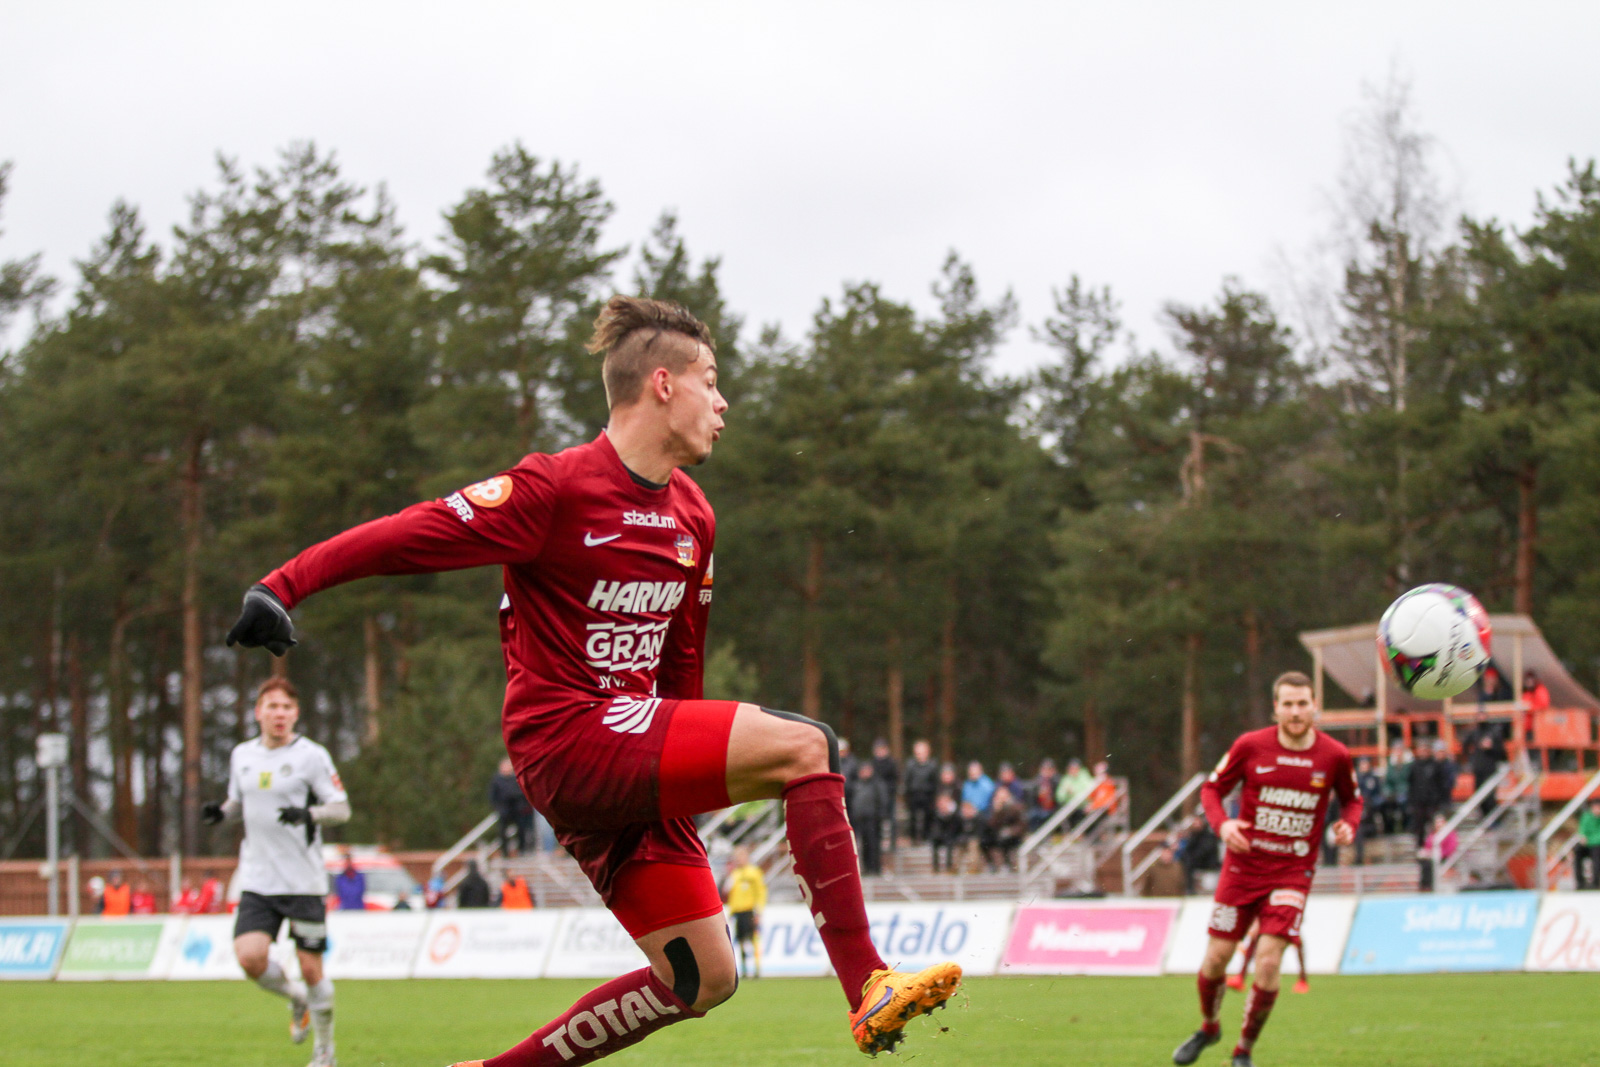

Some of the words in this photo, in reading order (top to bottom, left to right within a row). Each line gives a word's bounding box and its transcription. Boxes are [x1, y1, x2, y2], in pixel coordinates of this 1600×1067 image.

[622, 509, 677, 529] stadium
[586, 579, 687, 613] HARVIA
[585, 630, 667, 662] GRAN
[1258, 785, 1321, 811] HARVIA
[1254, 811, 1315, 835] GRANO
[541, 984, 682, 1062] TOTAL
